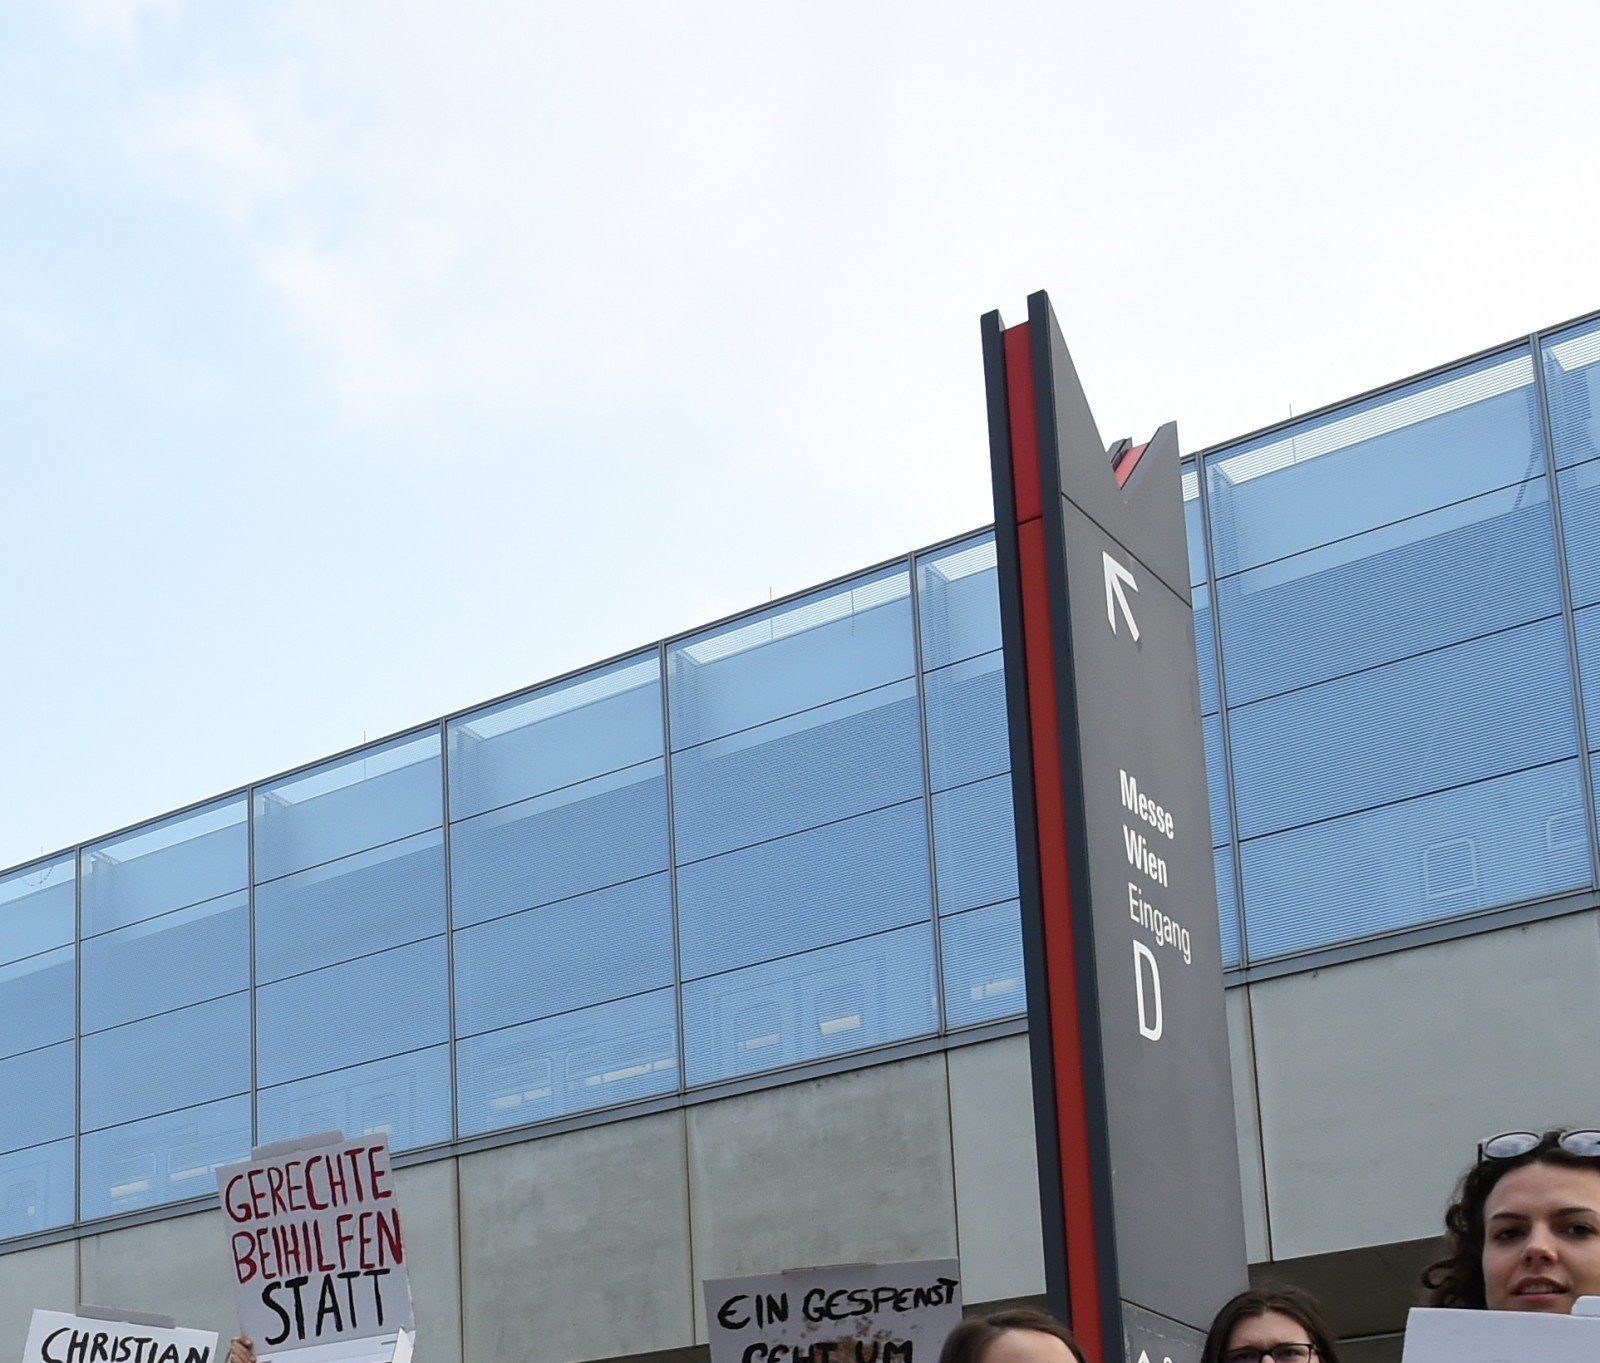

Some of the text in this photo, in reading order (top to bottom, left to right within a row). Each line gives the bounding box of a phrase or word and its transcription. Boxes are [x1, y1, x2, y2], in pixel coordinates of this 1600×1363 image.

[1119, 768, 1174, 840] Messe
[1122, 824, 1168, 888] Wien
[1128, 881, 1191, 965] Eingang
[1132, 939, 1163, 1041] D
[225, 1145, 392, 1223] GERECHTE
[232, 1208, 403, 1284] BEIHILFEN
[261, 1268, 391, 1346] STATT
[717, 1277, 959, 1329] EIN GESPENST
